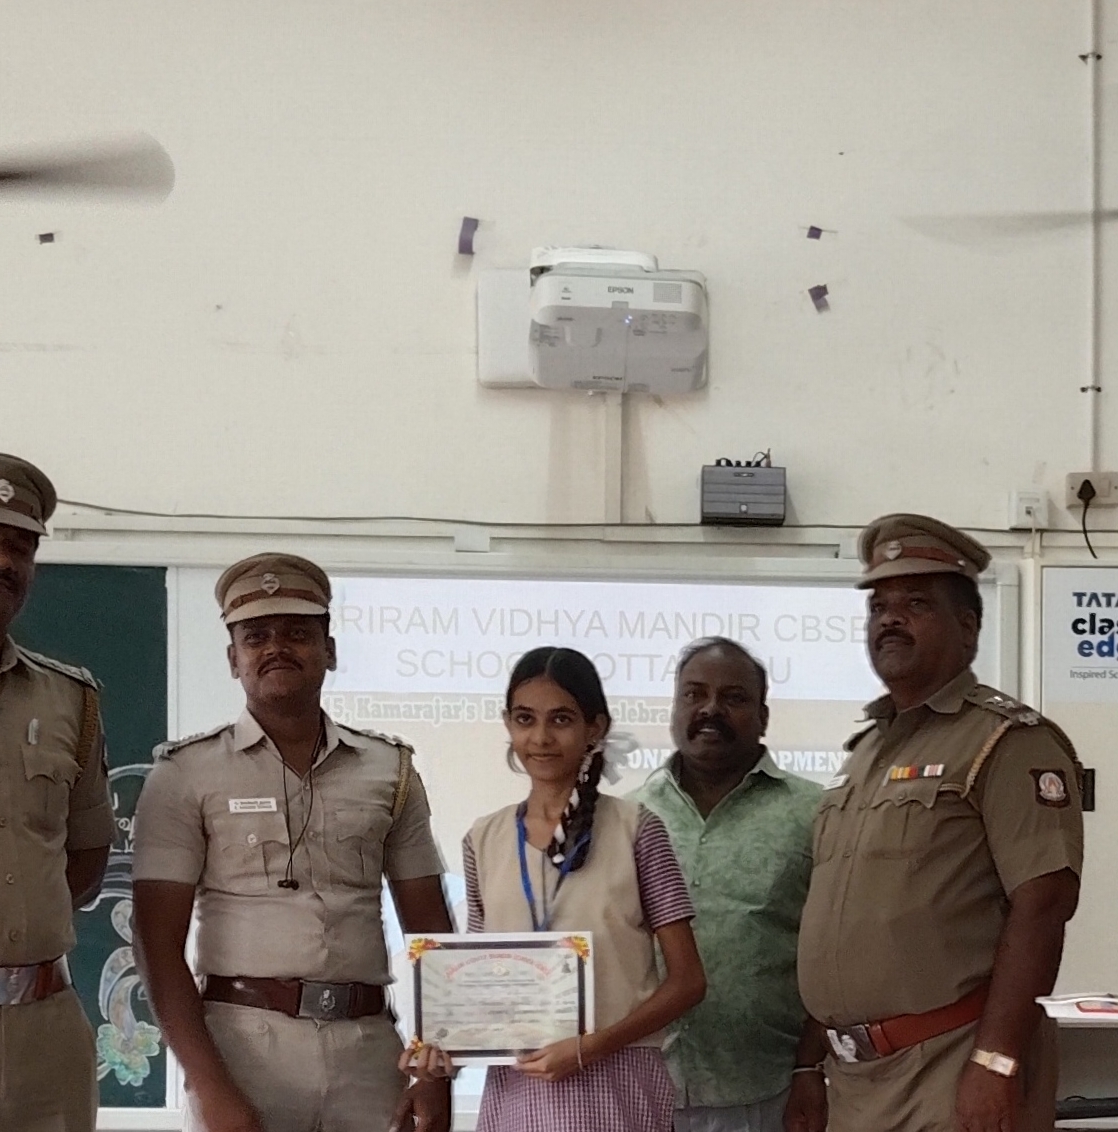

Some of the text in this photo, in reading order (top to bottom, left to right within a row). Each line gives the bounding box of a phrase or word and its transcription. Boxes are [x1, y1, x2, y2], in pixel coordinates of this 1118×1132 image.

[607, 286, 634, 294] EPSON
[1072, 592, 1118, 608] TAT
[472, 607, 608, 639] VIDHYA
[618, 611, 762, 642] MANDIR
[773, 614, 869, 644] CBSE
[1071, 613, 1118, 635] cla
[1077, 632, 1118, 661] ed
[396, 649, 523, 679] SCHO
[1070, 669, 1107, 680] Inspired
[356, 697, 478, 726] Kamarajar's
